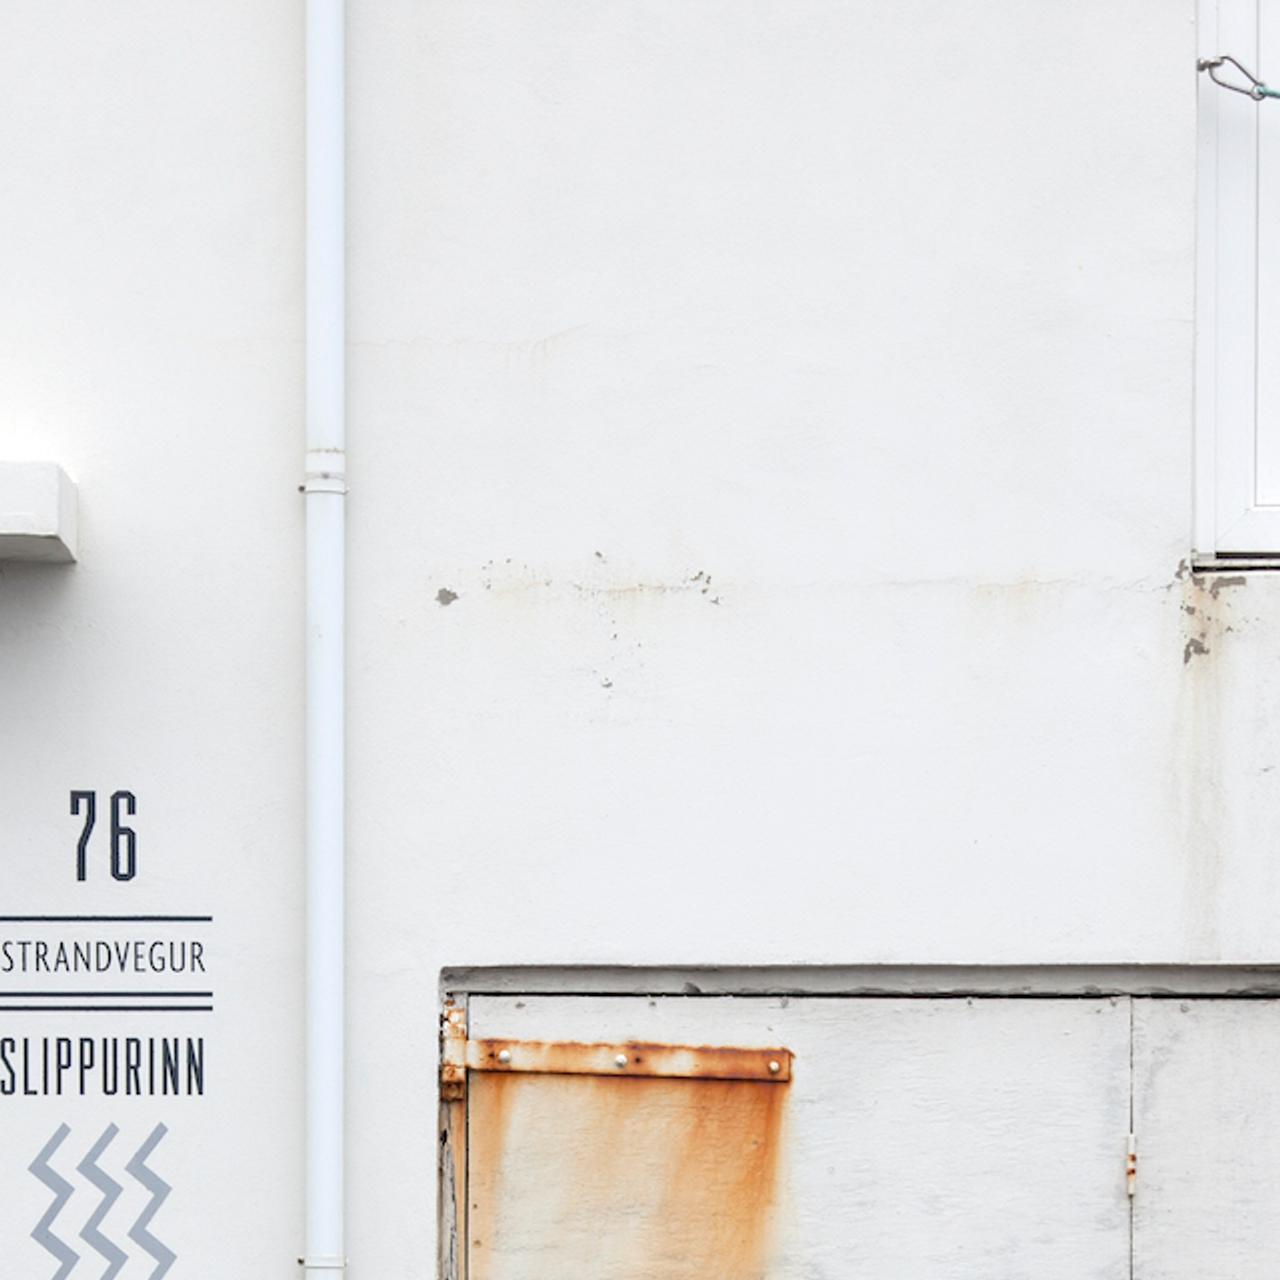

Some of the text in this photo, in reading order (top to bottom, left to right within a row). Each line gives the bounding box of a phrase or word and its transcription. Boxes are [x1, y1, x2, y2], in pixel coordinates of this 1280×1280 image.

[69, 789, 138, 882] 76
[1, 940, 206, 973] STRANDVEGUR
[0, 1036, 205, 1096] SLIPPURINN
